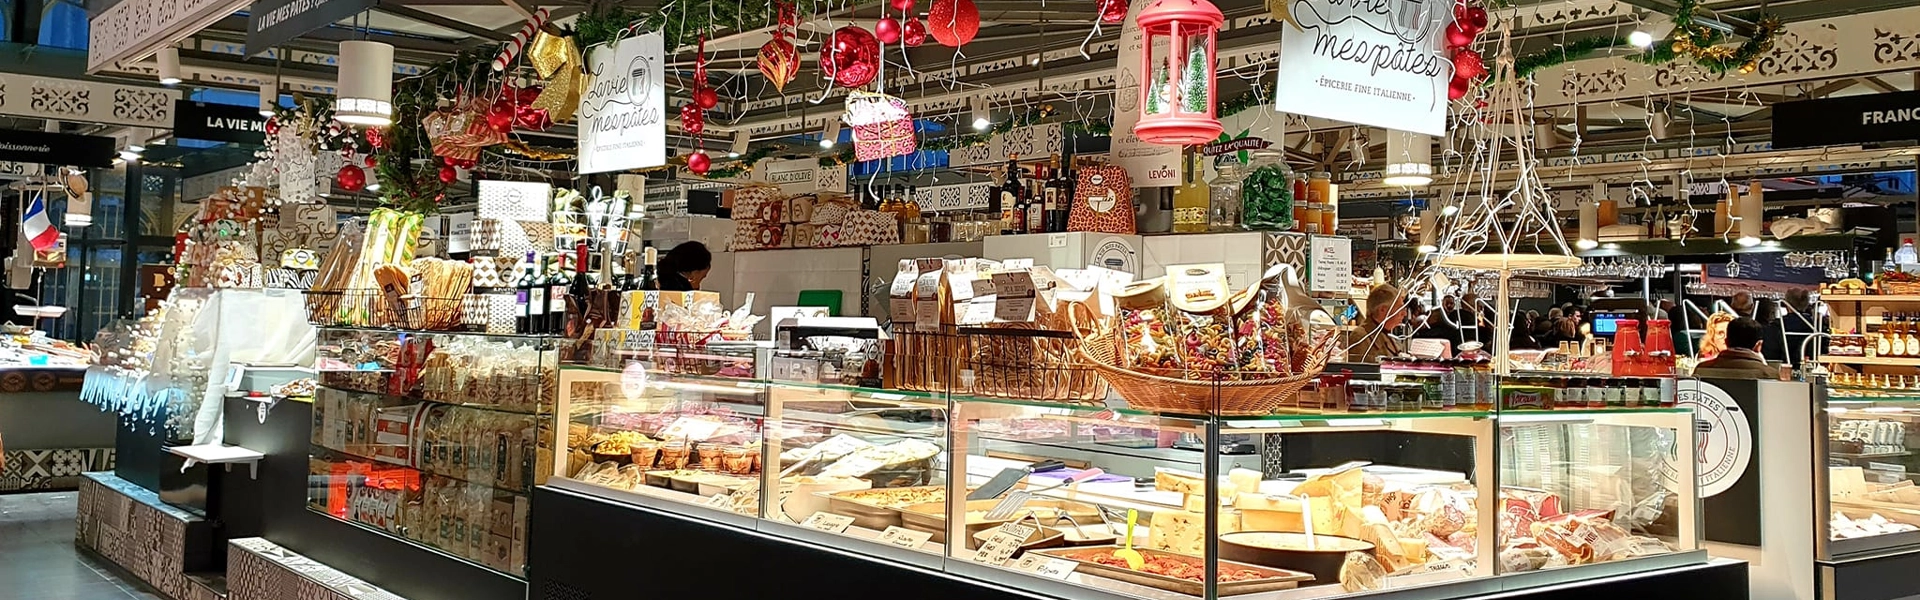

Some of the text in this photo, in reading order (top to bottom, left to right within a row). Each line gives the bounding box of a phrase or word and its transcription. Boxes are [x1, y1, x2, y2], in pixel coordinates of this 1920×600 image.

[257, 15, 266, 32] LA
[266, 10, 277, 28] VIE
[276, 4, 291, 23] MES
[1319, 75, 1412, 102] ÉPICERIE FINE ITALIENNE
[207, 116, 224, 129] LA
[226, 118, 248, 130] VIE
[0, 142, 50, 153] oissonnerie
[771, 173, 789, 182] BLANC
